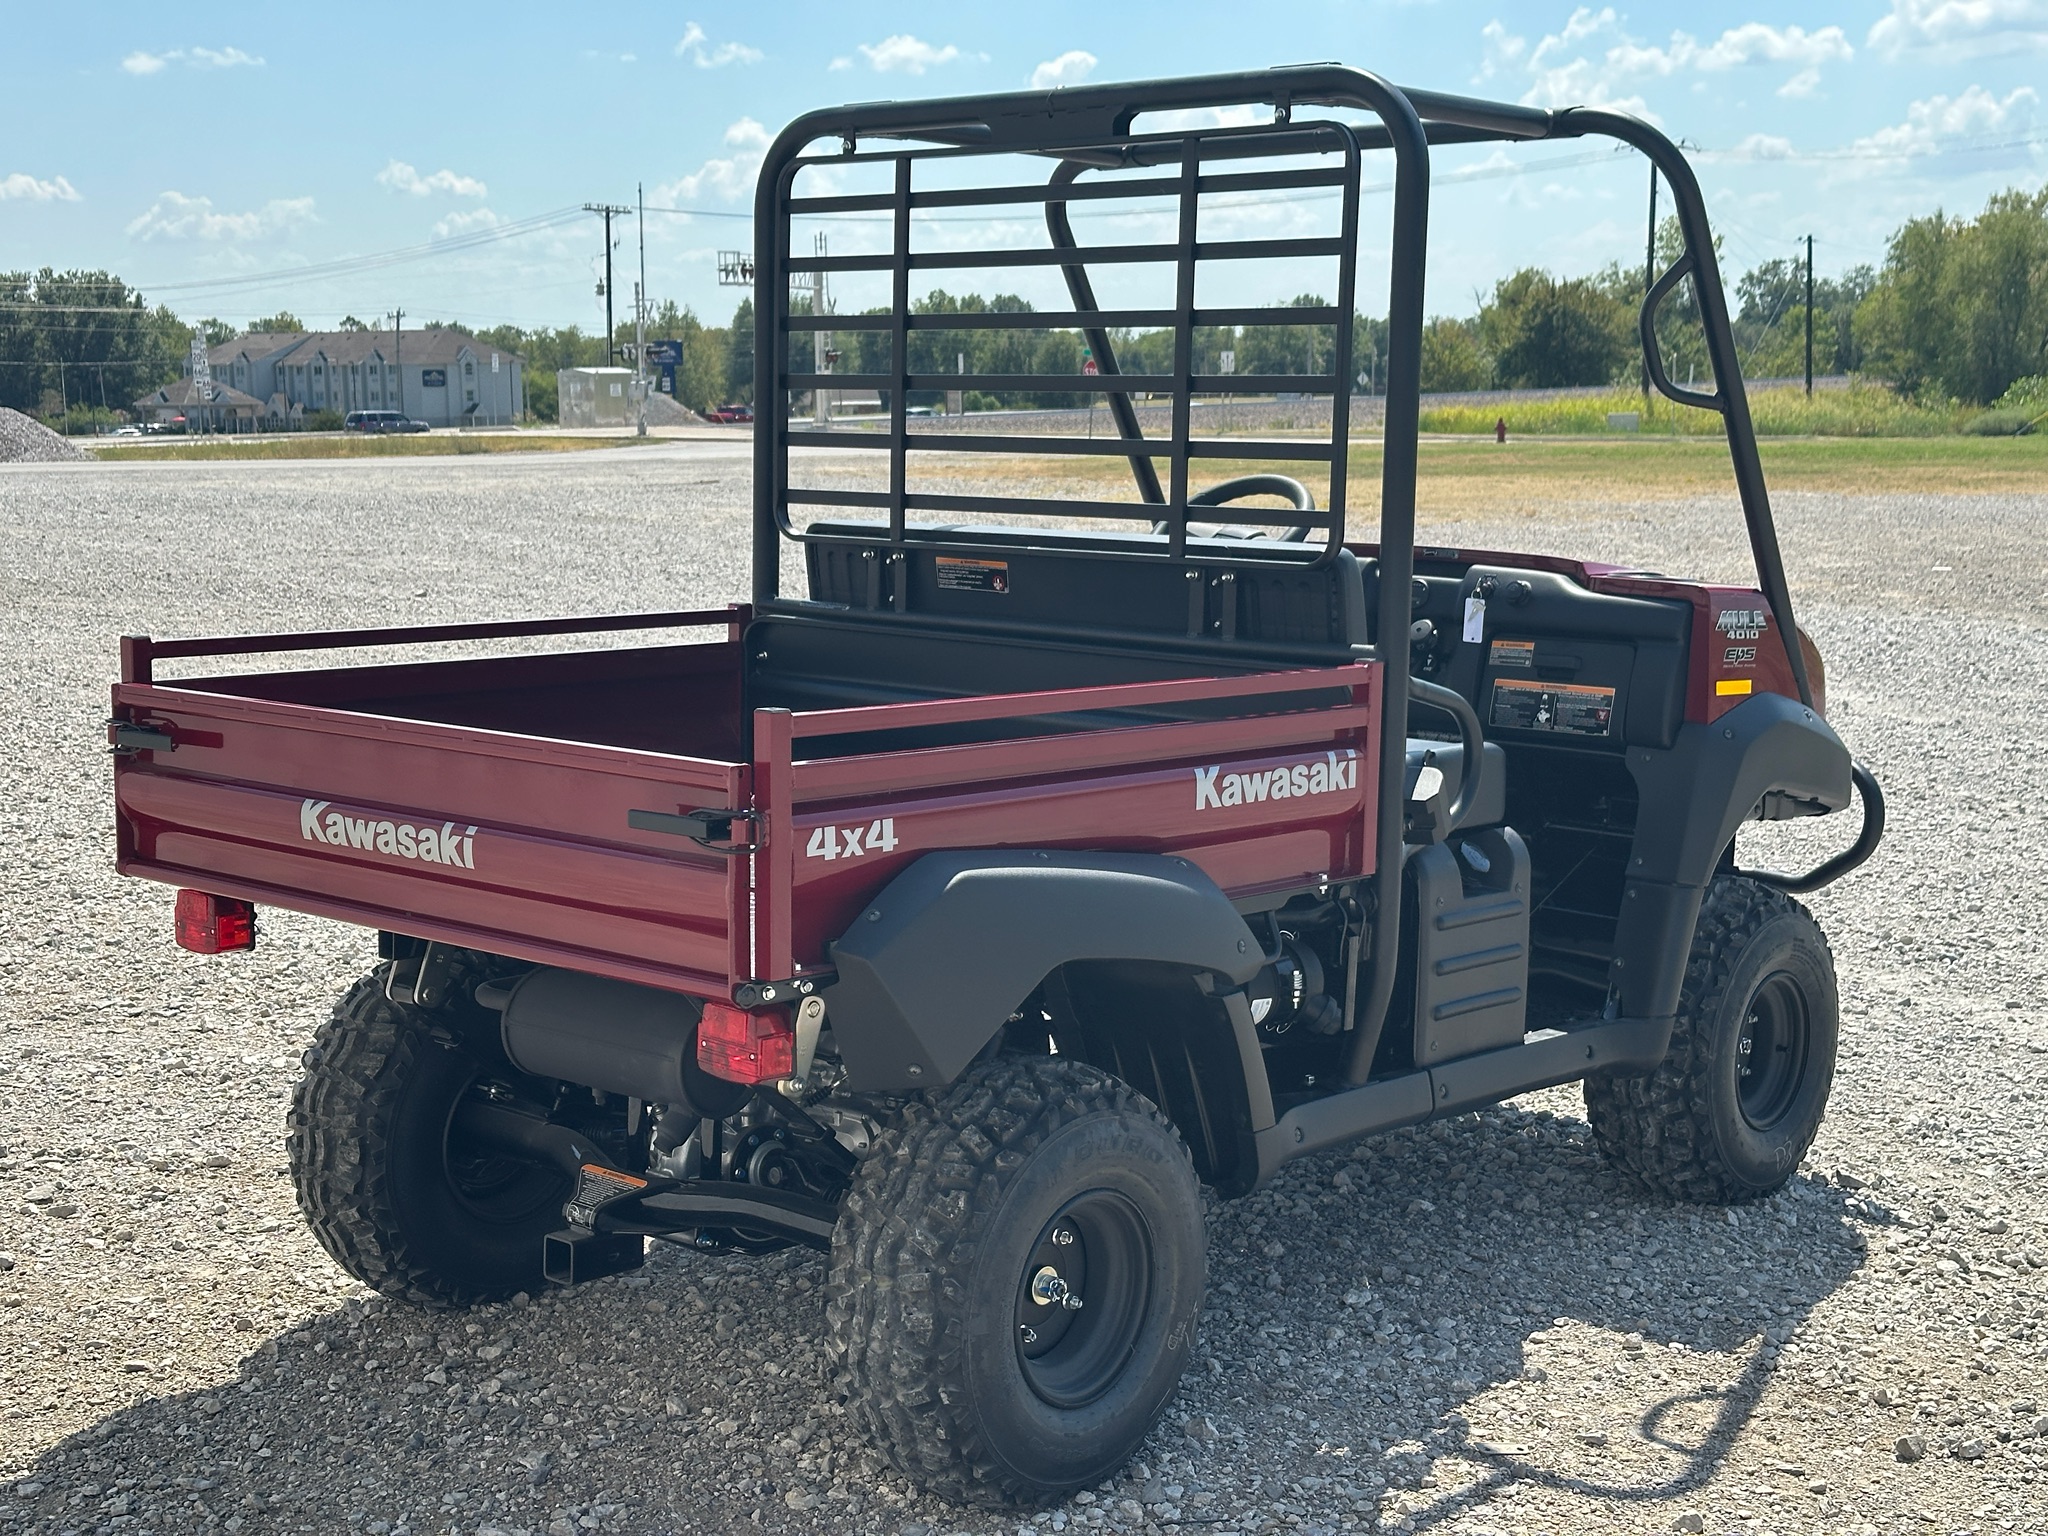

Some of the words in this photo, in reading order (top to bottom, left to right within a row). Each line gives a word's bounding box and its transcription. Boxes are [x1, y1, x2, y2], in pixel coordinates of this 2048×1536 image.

[1085, 367, 1098, 375] STO
[1715, 610, 1768, 631] MULE
[1727, 630, 1759, 639] 4010
[1723, 647, 1757, 664] EPS
[1194, 748, 1357, 811] Kawasaki
[300, 798, 479, 870] Kawasaki
[806, 817, 899, 861] 4x4
